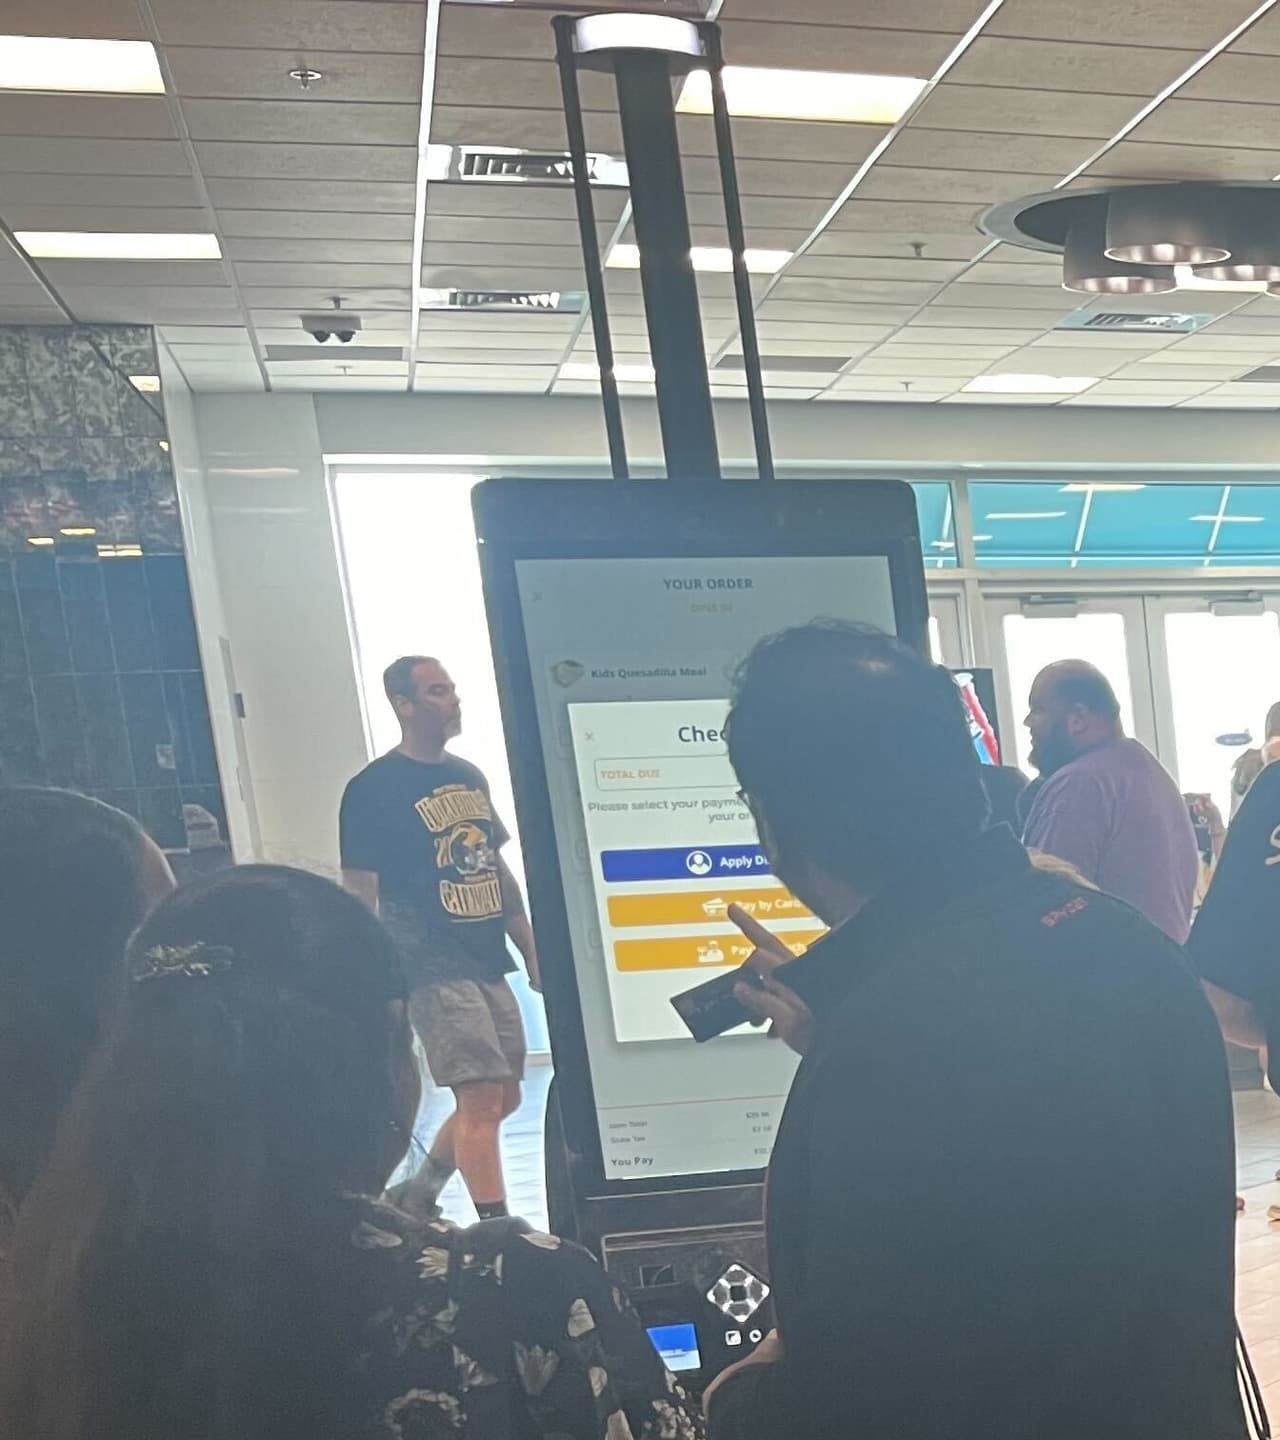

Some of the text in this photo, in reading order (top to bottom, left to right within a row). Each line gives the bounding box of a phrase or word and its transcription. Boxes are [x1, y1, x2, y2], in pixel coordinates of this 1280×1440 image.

[663, 578, 753, 590] YOUR ORDER
[591, 667, 707, 679] Kids Quesadilla Meal
[600, 768, 661, 780] TOTAL DUE
[588, 802, 629, 812] Please
[631, 800, 669, 811] select
[671, 800, 698, 812] your
[708, 812, 735, 824] your
[720, 855, 753, 868] Apply
[758, 900, 773, 912] by
[611, 1156, 654, 1167] You Pay
